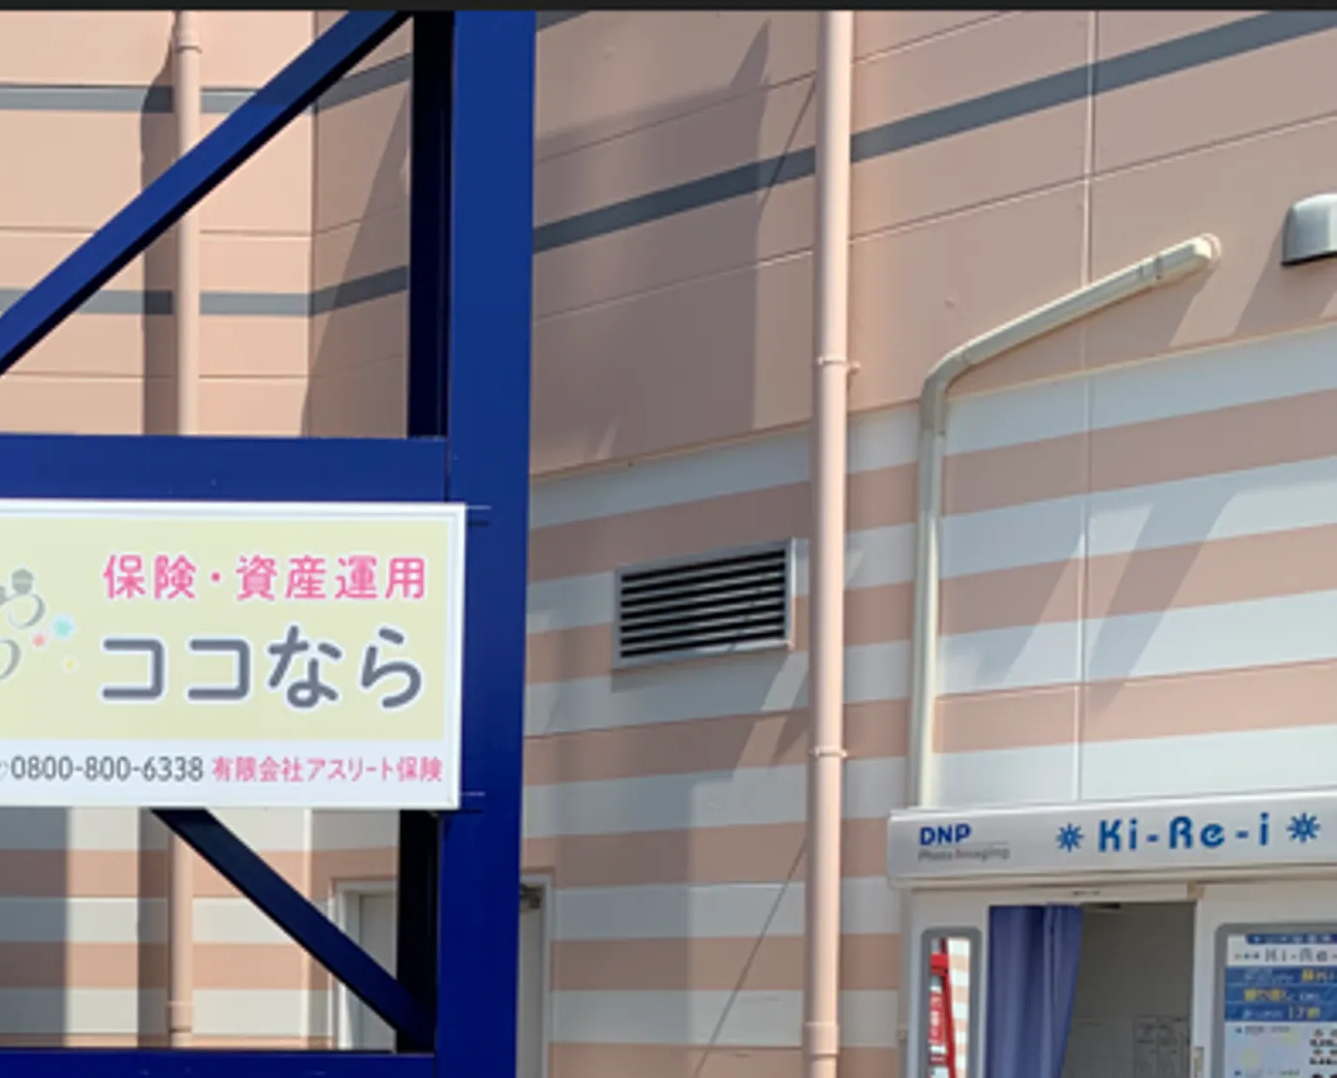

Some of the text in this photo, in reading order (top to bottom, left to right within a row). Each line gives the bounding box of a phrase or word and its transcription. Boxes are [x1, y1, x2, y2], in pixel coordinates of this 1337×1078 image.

[103, 554, 426, 601] 保険・資産運用
[102, 625, 422, 709] ココなら
[10, 755, 205, 782] 0800-800-6338
[212, 755, 443, 783] 有限会社アスリート保険
[919, 823, 973, 846] DNP
[1098, 812, 1270, 853] Ki-Re-i
